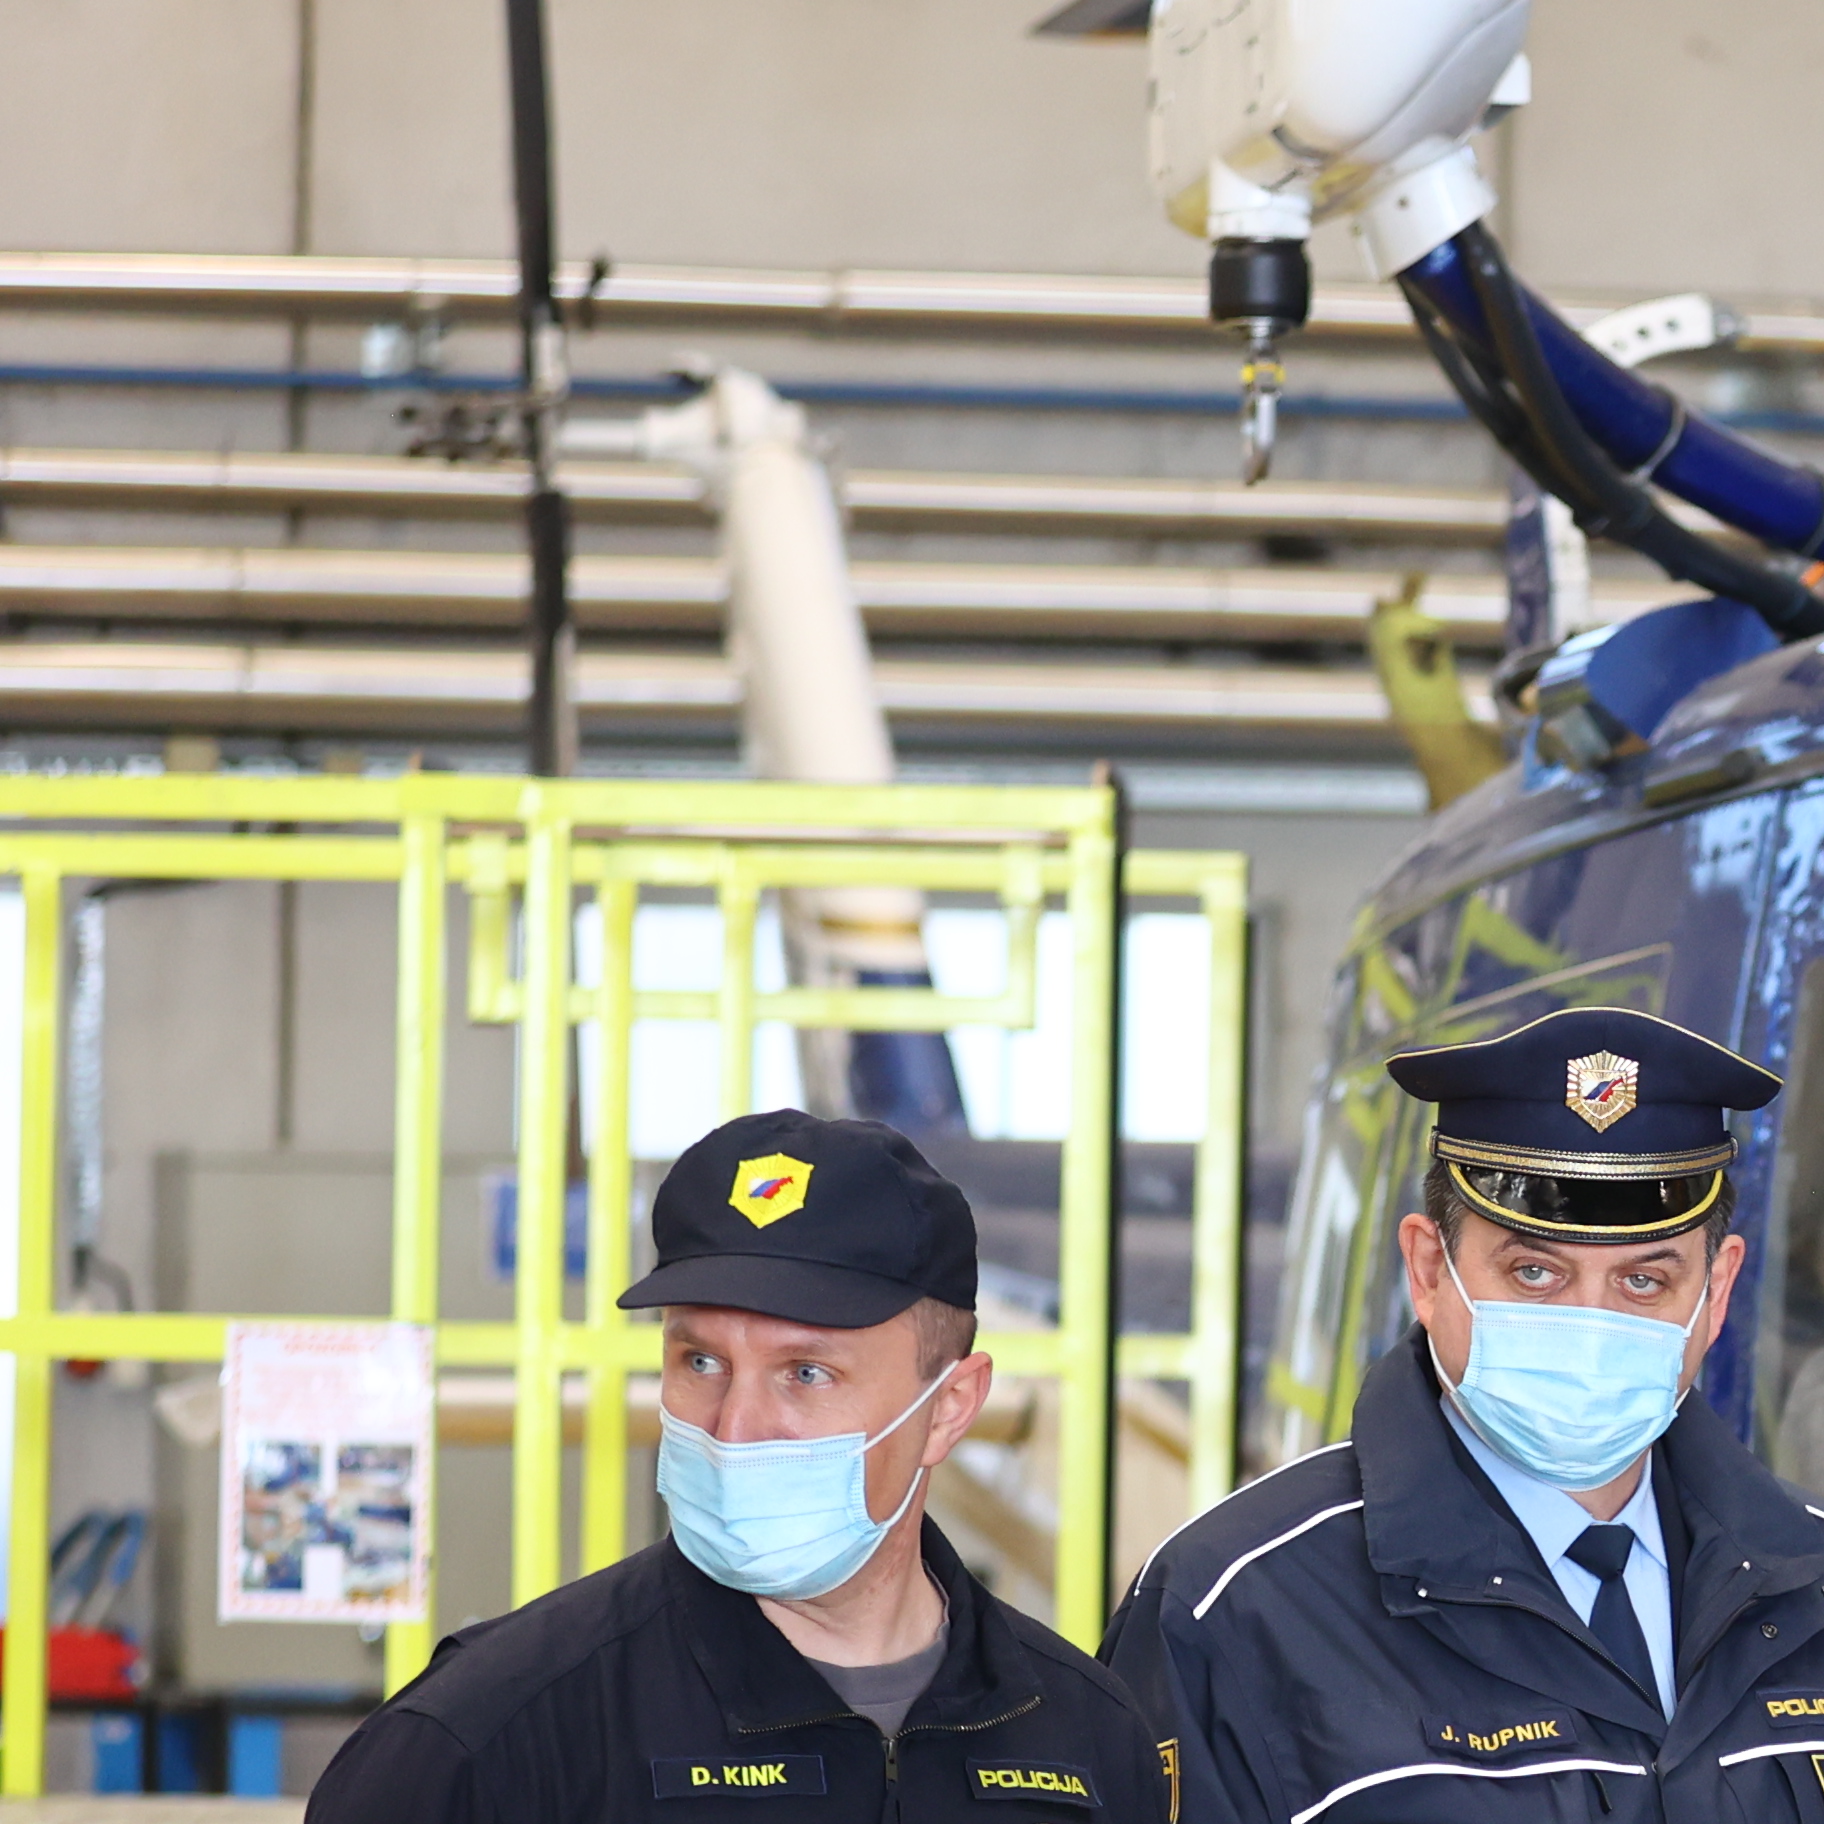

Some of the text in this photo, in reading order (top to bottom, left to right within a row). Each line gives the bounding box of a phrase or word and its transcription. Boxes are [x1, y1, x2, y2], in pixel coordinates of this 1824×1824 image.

[1440, 1720, 1562, 1751] J. RUPNIK
[690, 1763, 788, 1786] D. KINK
[977, 1768, 1089, 1798] POLICIJA
